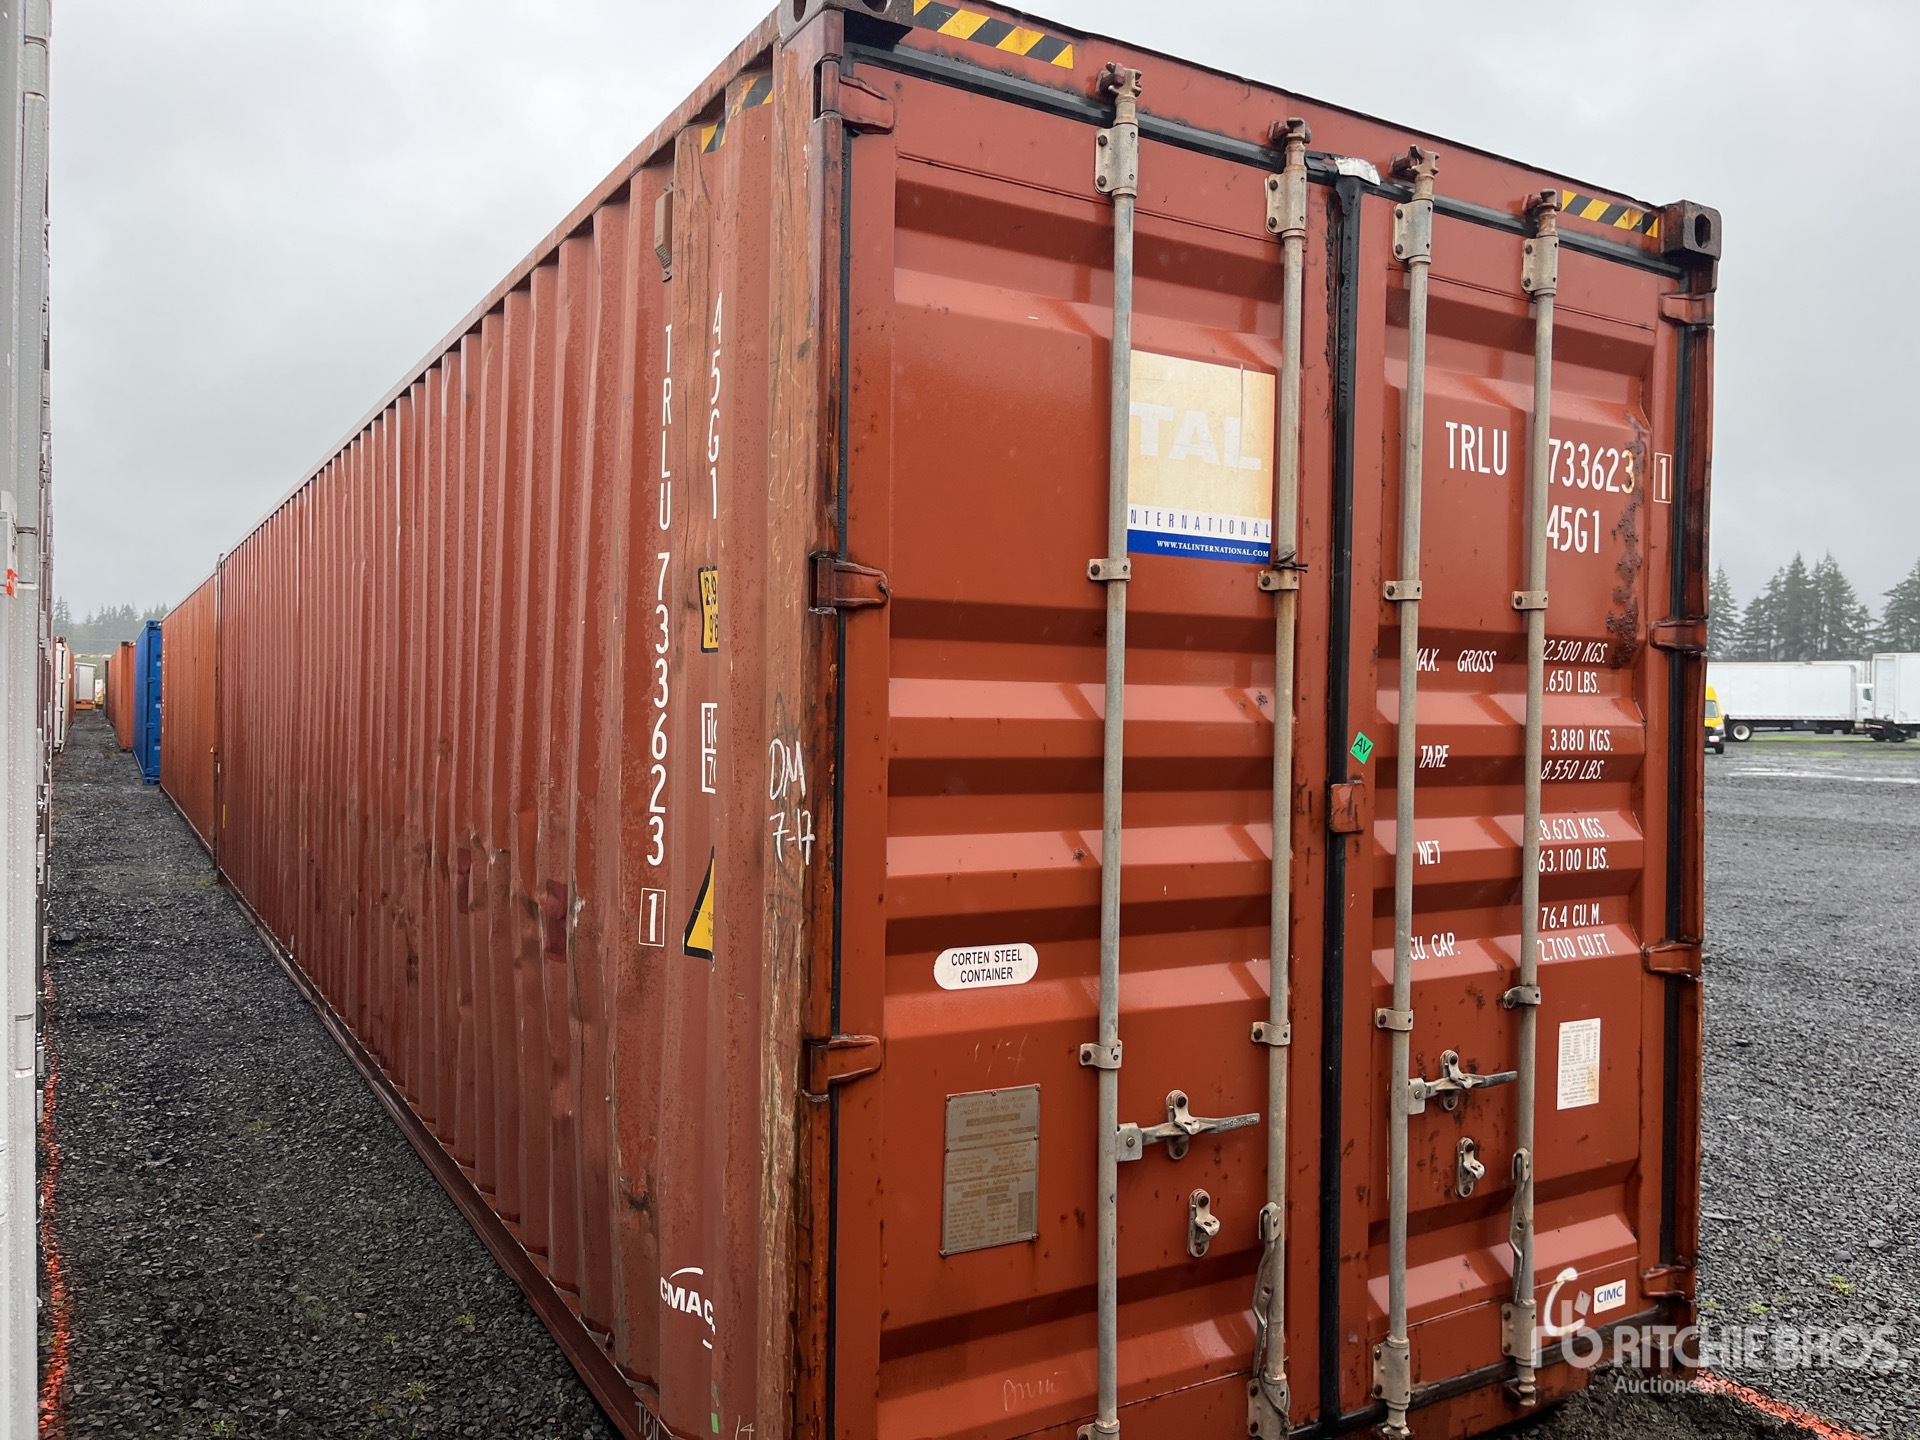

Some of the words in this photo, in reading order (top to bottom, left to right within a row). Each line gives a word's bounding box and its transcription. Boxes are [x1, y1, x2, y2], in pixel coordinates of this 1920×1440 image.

[707, 291, 722, 519] 45G1
[659, 324, 672, 530] TRLU
[1130, 401, 1262, 471] TAL
[1445, 422, 1508, 476] TRLU
[1549, 439, 1636, 494] 733623
[1131, 508, 1271, 538] NTERNATIONAL
[1547, 504, 1600, 554] 45G1
[1156, 539, 1269, 558] WWW.TALINTERNATIONAL.COM
[1457, 650, 1497, 673] GROSS
[1581, 642, 1608, 663] KGS.
[1545, 670, 1572, 692] ,650
[1577, 671, 1600, 693] LBS.
[647, 552, 670, 867] 733623
[1353, 737, 1372, 755] AV
[1419, 744, 1449, 769] TARE
[1549, 728, 1584, 751] 3,880
[1589, 729, 1613, 751] KGS.
[769, 738, 806, 800] DM
[1541, 760, 1579, 780] 8,550
[1579, 760, 1604, 780] LBS.
[1417, 841, 1441, 865] NET
[1539, 818, 1578, 840] 8,620
[1578, 818, 1609, 839] KGS.
[1538, 848, 1581, 873] 63,100
[1586, 847, 1609, 870] LBS.
[1541, 905, 1567, 930] 76.4
[1431, 932, 1461, 957] CAP.
[951, 950, 990, 966] CORTEN
[994, 949, 1022, 963] STEEL
[960, 967, 1013, 983] CONTAINER
[1597, 1285, 1623, 1304] CIMC
